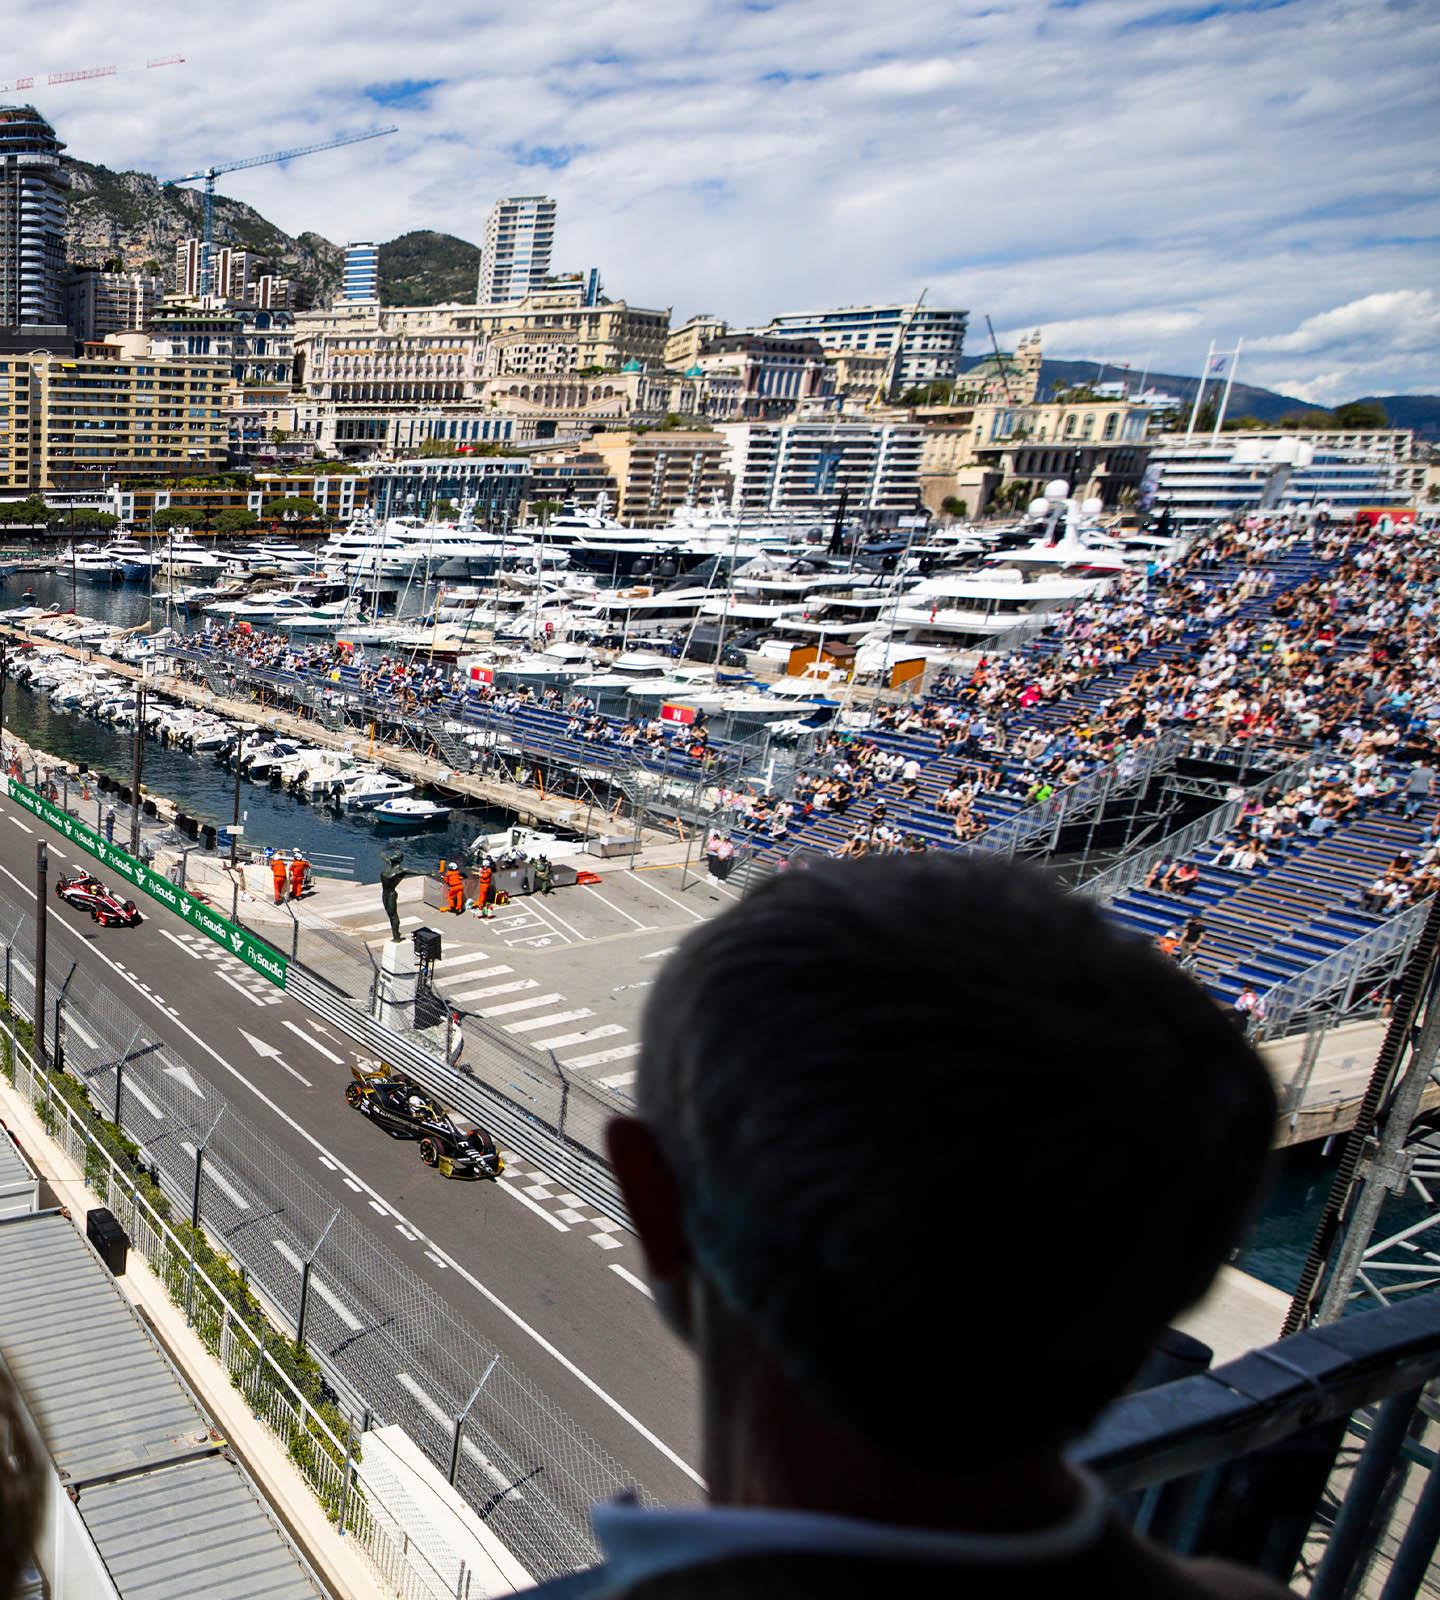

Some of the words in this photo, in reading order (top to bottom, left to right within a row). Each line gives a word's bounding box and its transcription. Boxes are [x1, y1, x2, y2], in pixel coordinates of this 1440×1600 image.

[673, 709, 682, 721] N
[109, 852, 133, 875] FlySaudia
[148, 878, 176, 904] FlySaudia
[195, 910, 227, 939] FlySaudia
[248, 946, 283, 980] FlySaudia
